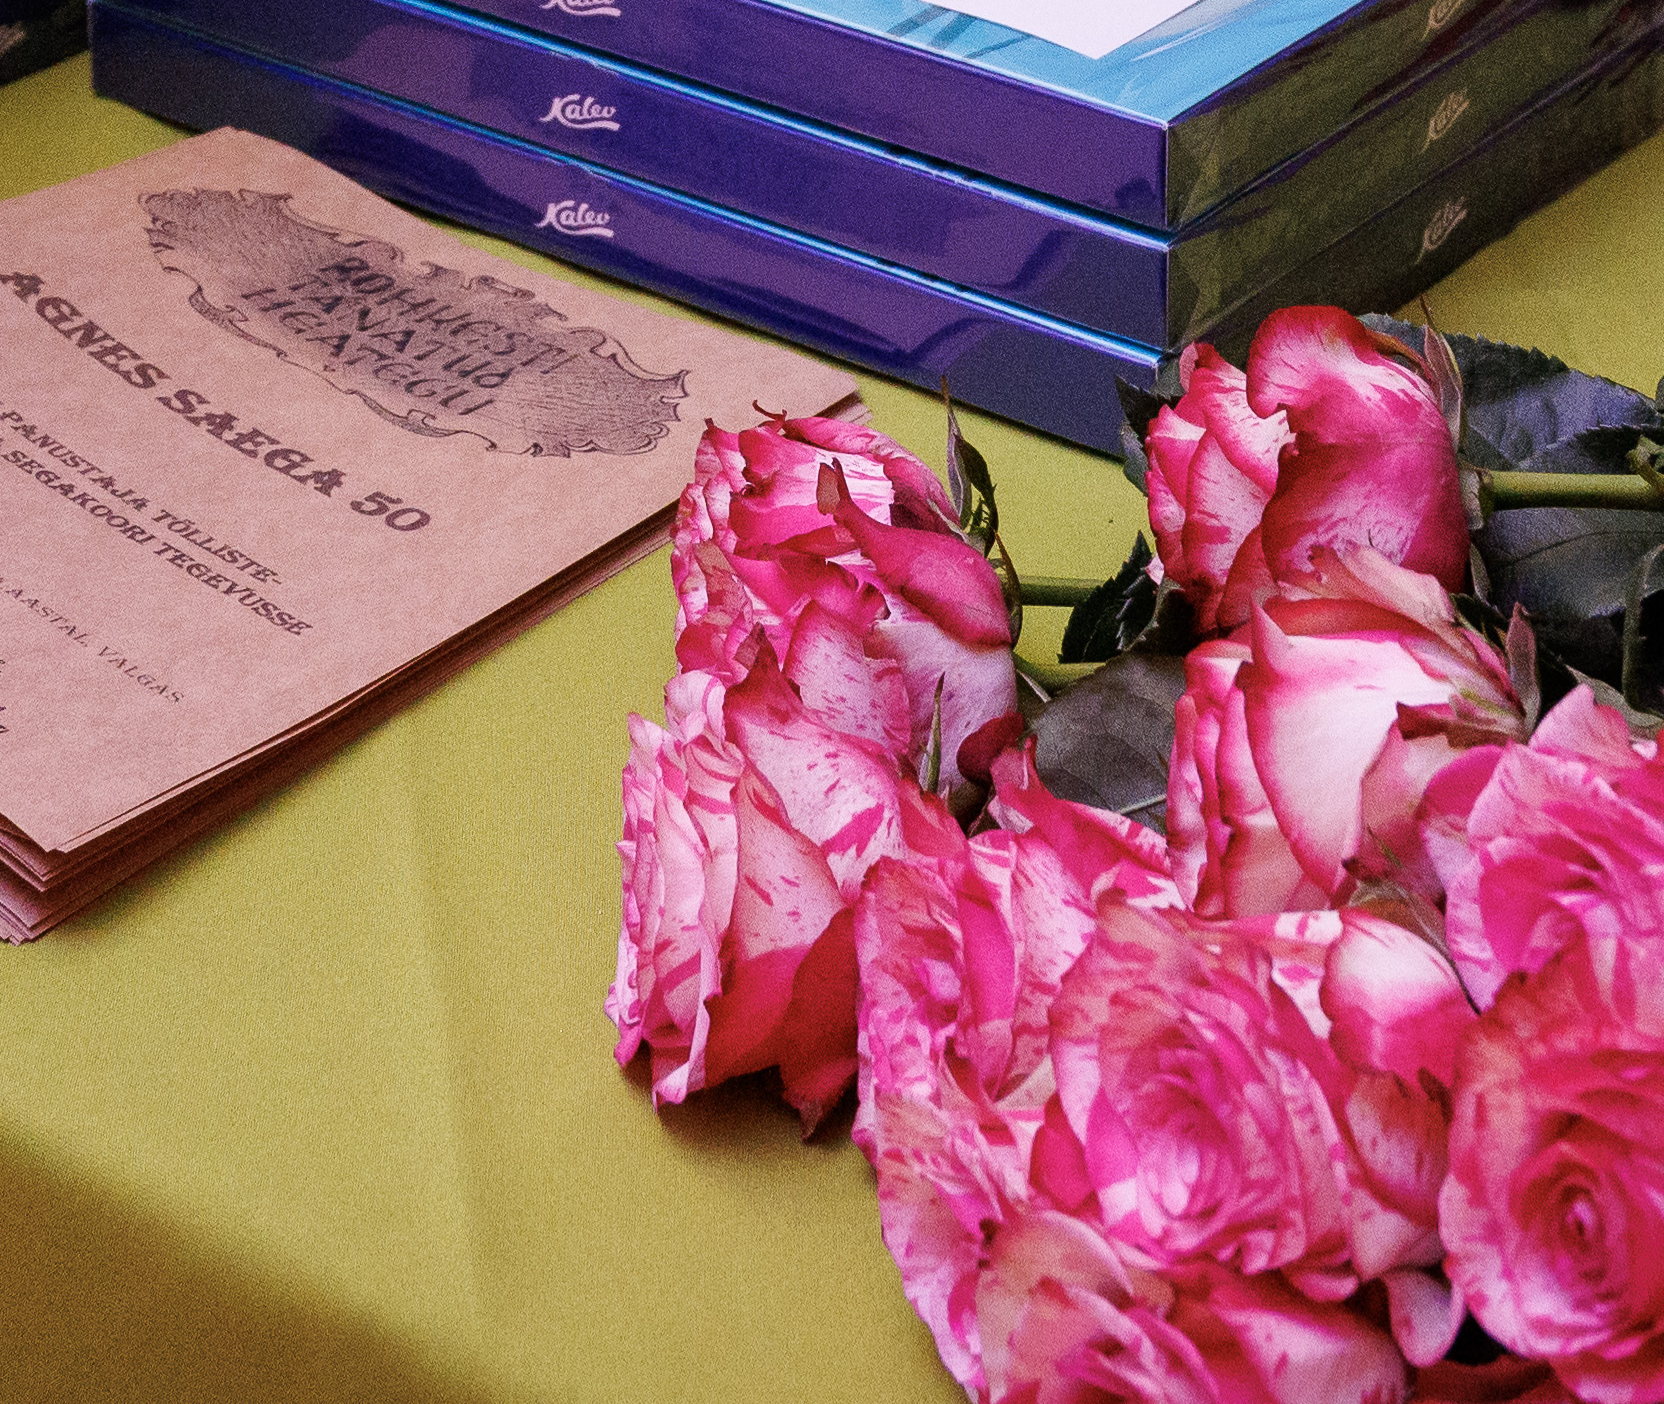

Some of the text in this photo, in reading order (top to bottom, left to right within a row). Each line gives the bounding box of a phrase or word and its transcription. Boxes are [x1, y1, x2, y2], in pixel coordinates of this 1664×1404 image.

[539, 93, 621, 132] Kalev
[533, 199, 615, 238] Kalev
[155, 388, 348, 498] SAEGA
[349, 491, 431, 532] 50
[1, 450, 157, 545] SEGAKOORI
[153, 542, 313, 636] TEGEVUSSE
[152, 509, 283, 585] TÕLLISTE-
[98, 646, 184, 703] VALGAS
